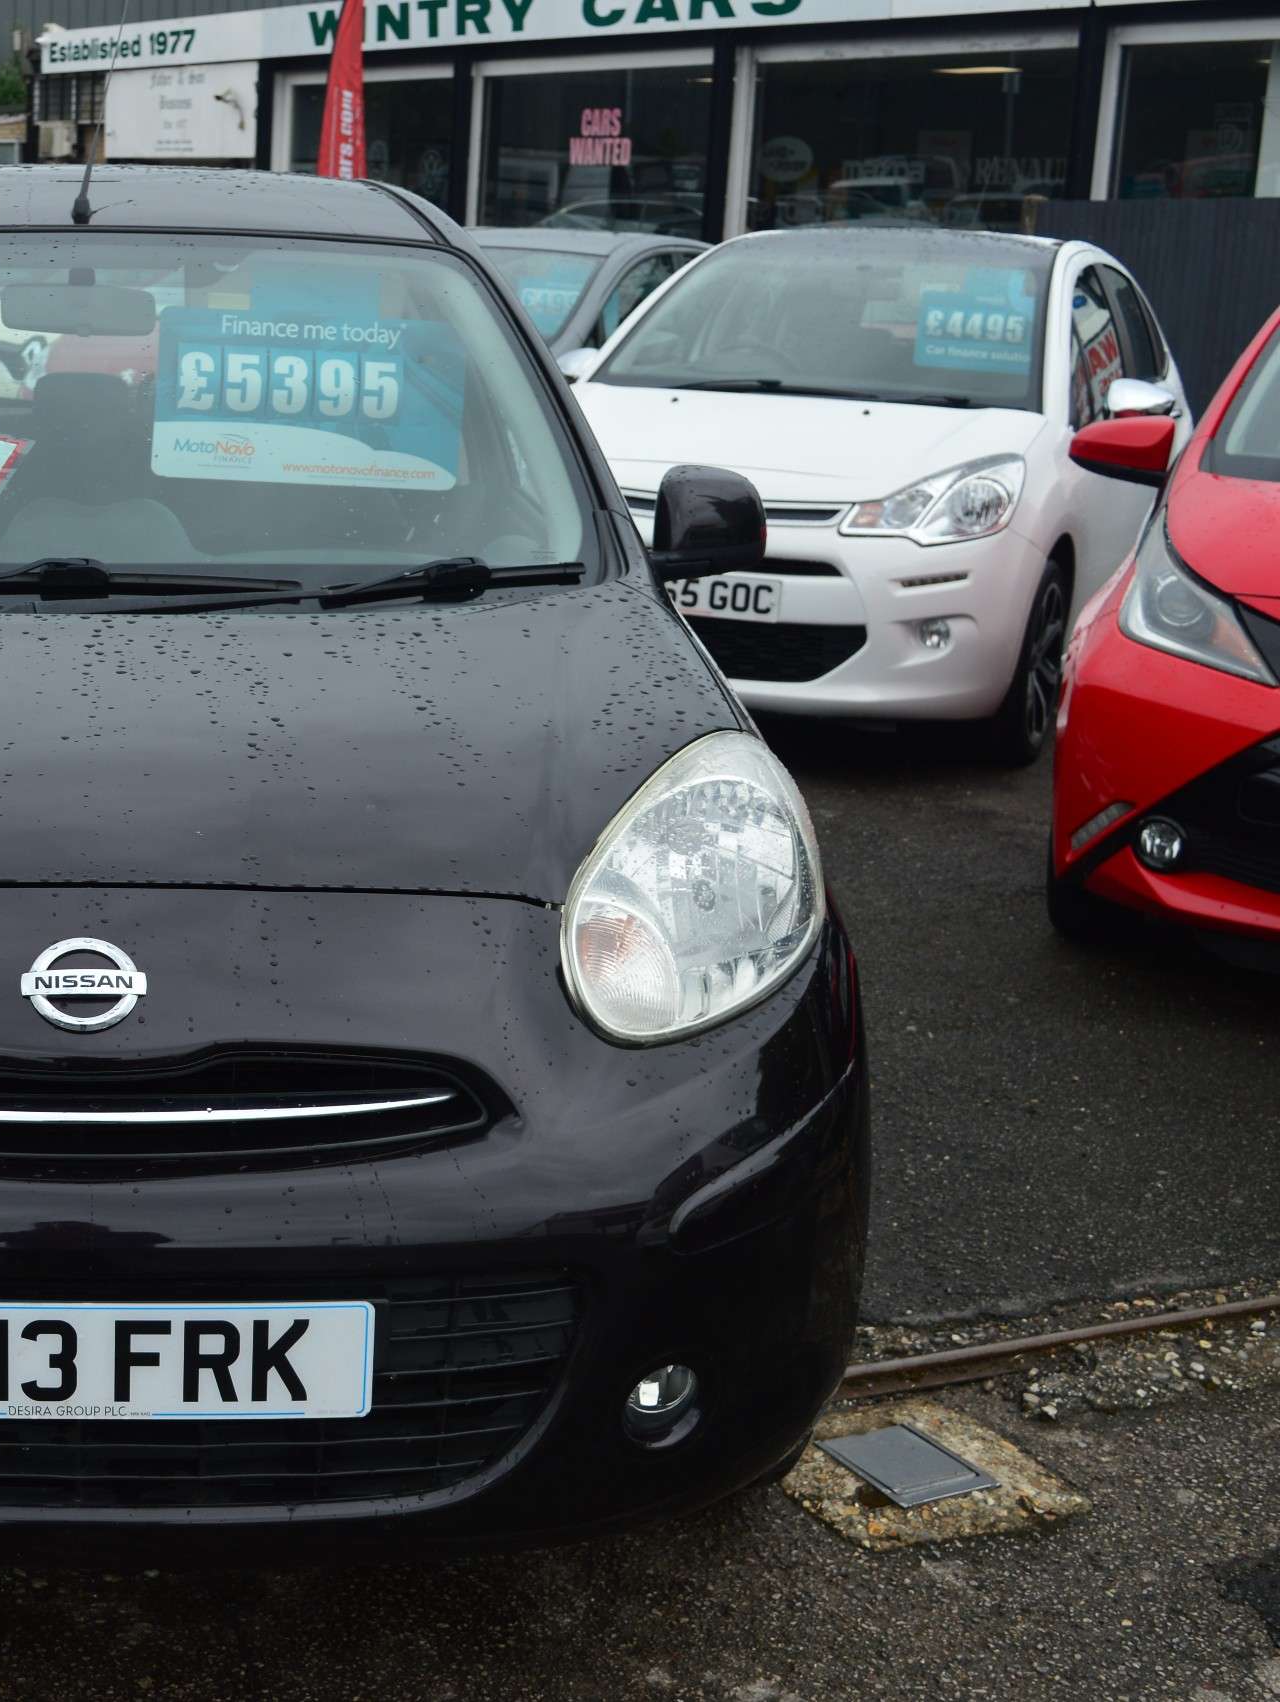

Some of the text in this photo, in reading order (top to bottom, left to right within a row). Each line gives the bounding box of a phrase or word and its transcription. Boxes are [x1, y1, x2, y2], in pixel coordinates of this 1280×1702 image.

[308, 0, 532, 47] WNTRY
[49, 29, 196, 63] Established 1977
[338, 89, 354, 180] ars.com
[580, 108, 622, 136] CARS
[569, 137, 632, 167] WANTED
[220, 314, 299, 339] Finance
[303, 324, 338, 341] me
[925, 309, 1025, 343] £4495
[176, 351, 400, 420] £5395
[173, 437, 256, 456] MotoNovo
[281, 461, 436, 481] www.motonovofinance.com
[708, 580, 774, 615] GOC
[34, 974, 133, 990] NISSAN
[113, 1318, 310, 1403] FRK
[7, 1404, 53, 1417] DESIRA
[56, 1404, 102, 1417] GROUP
[104, 1404, 128, 1417] PLC
